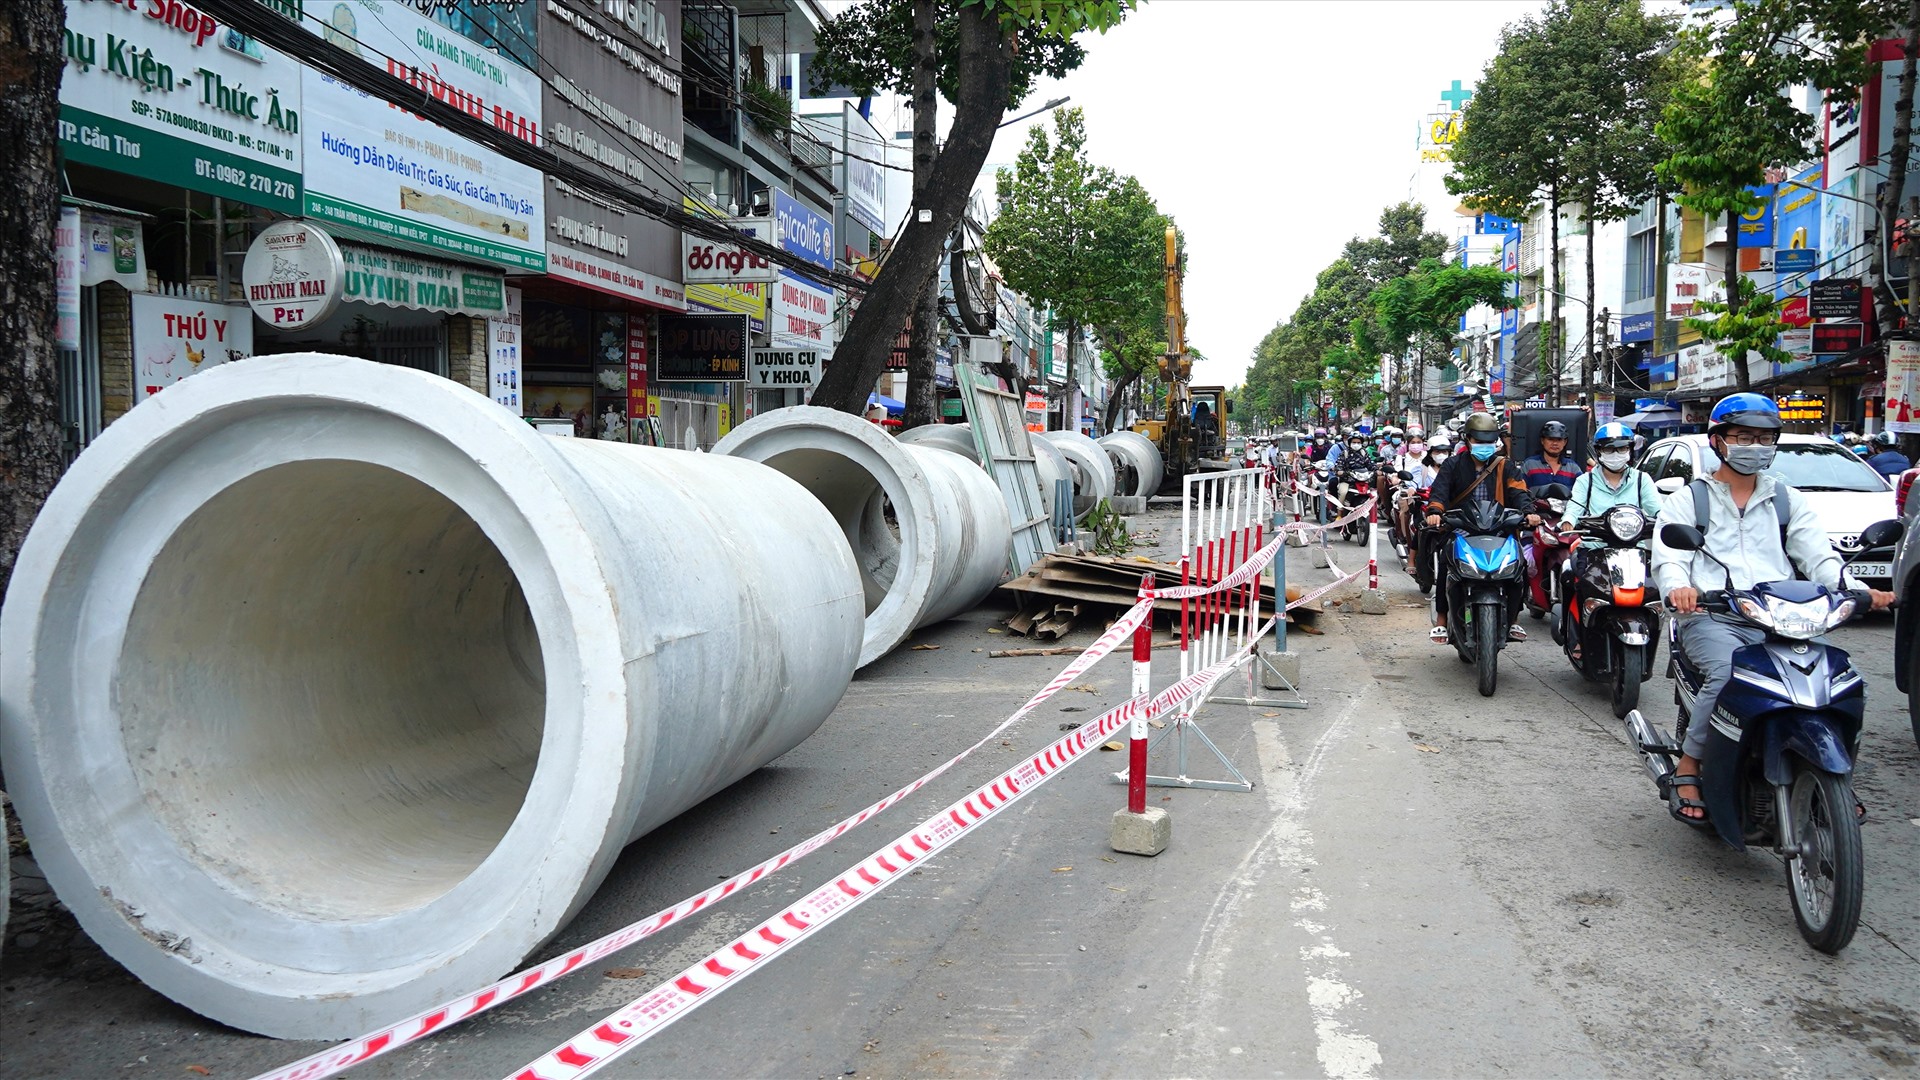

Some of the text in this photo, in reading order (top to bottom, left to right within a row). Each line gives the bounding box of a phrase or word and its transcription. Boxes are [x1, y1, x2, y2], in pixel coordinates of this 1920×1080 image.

[417, 26, 434, 52] CỬA
[437, 36, 459, 63] HÀNG
[461, 50, 486, 77] THUỐC
[107, 33, 173, 92] Kiện
[198, 68, 258, 119] Thức
[267, 87, 298, 134] Ăn
[131, 99, 153, 118] SGP:
[81, 126, 110, 151] Cần
[114, 135, 140, 159] Thơ
[216, 164, 246, 188] 0962
[250, 173, 271, 194] 270
[274, 181, 295, 200] 276
[322, 131, 360, 166] Hướng
[363, 146, 384, 169] Dẫn
[428, 168, 443, 188] Gia
[464, 181, 478, 199] Gia
[556, 216, 582, 245] PHỤC
[779, 205, 821, 255] microlife
[250, 280, 326, 300] HUỲNH MAI
[345, 266, 409, 303] UỲNH
[417, 281, 458, 309] MAI
[782, 283, 799, 307] DỤNG
[800, 290, 807, 313] CỤ
[808, 293, 812, 310] Y
[813, 294, 826, 315] KHOA
[163, 311, 228, 342] THÚ Y
[787, 314, 806, 336] THANH
[712, 354, 720, 371] ÉP
[722, 354, 740, 372] KÍNH
[755, 352, 816, 368] DỤNG CỤ
[760, 371, 811, 384] Y KHOA
[1716, 704, 1740, 727] YAMAHA
